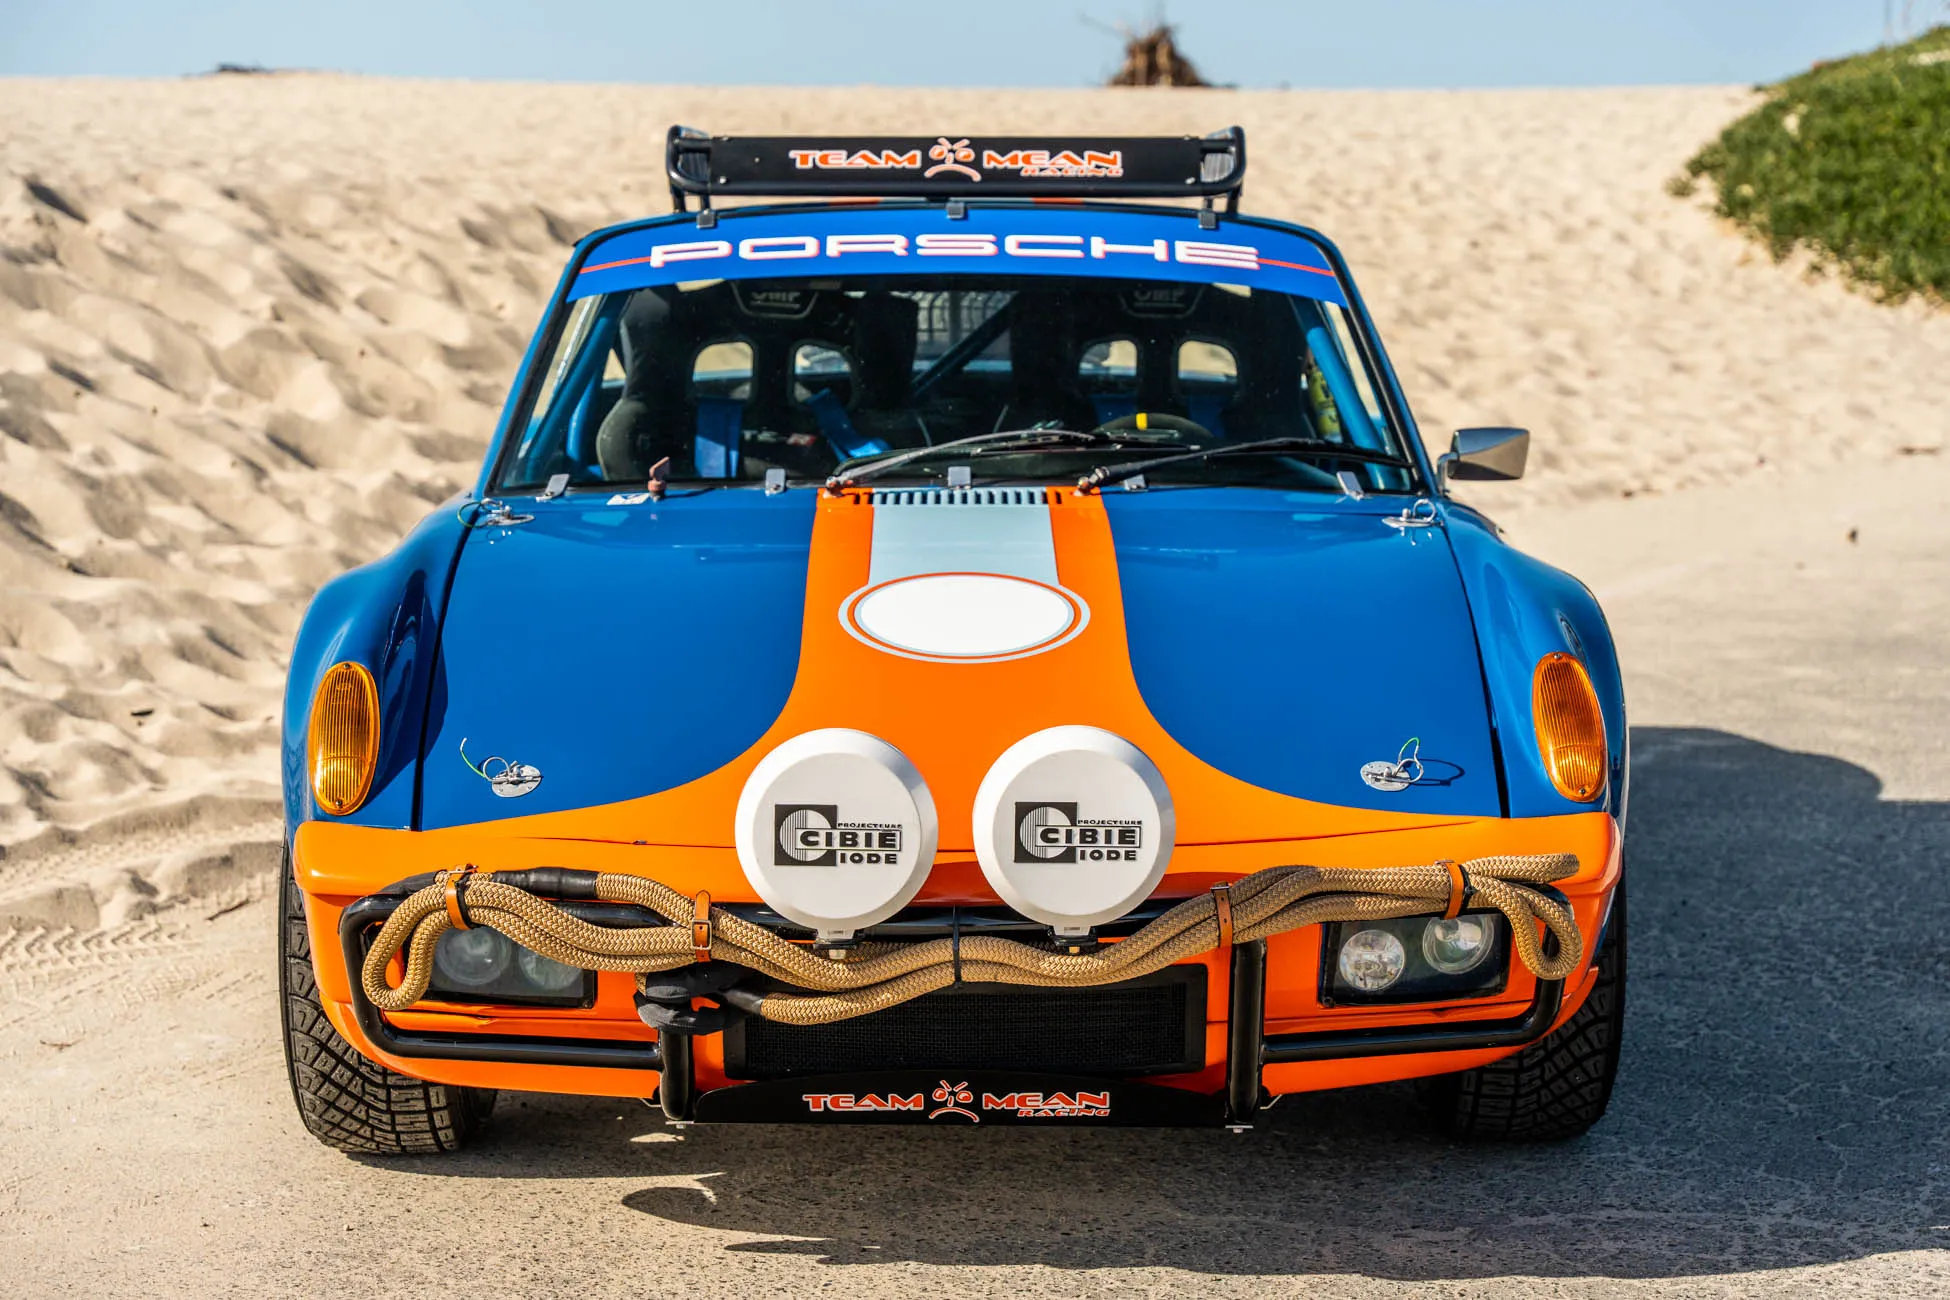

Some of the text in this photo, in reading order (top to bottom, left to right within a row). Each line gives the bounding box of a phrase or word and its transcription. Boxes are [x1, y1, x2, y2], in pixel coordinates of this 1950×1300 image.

[789, 150, 1122, 169] TEAM MEAN
[1020, 166, 1124, 177] RACING
[650, 234, 1260, 270] PORSCHE
[839, 853, 898, 864] IODE
[1079, 849, 1137, 861] IODE
[802, 1091, 1110, 1111] TEAM MEAN
[1017, 1108, 1111, 1117] RACING
